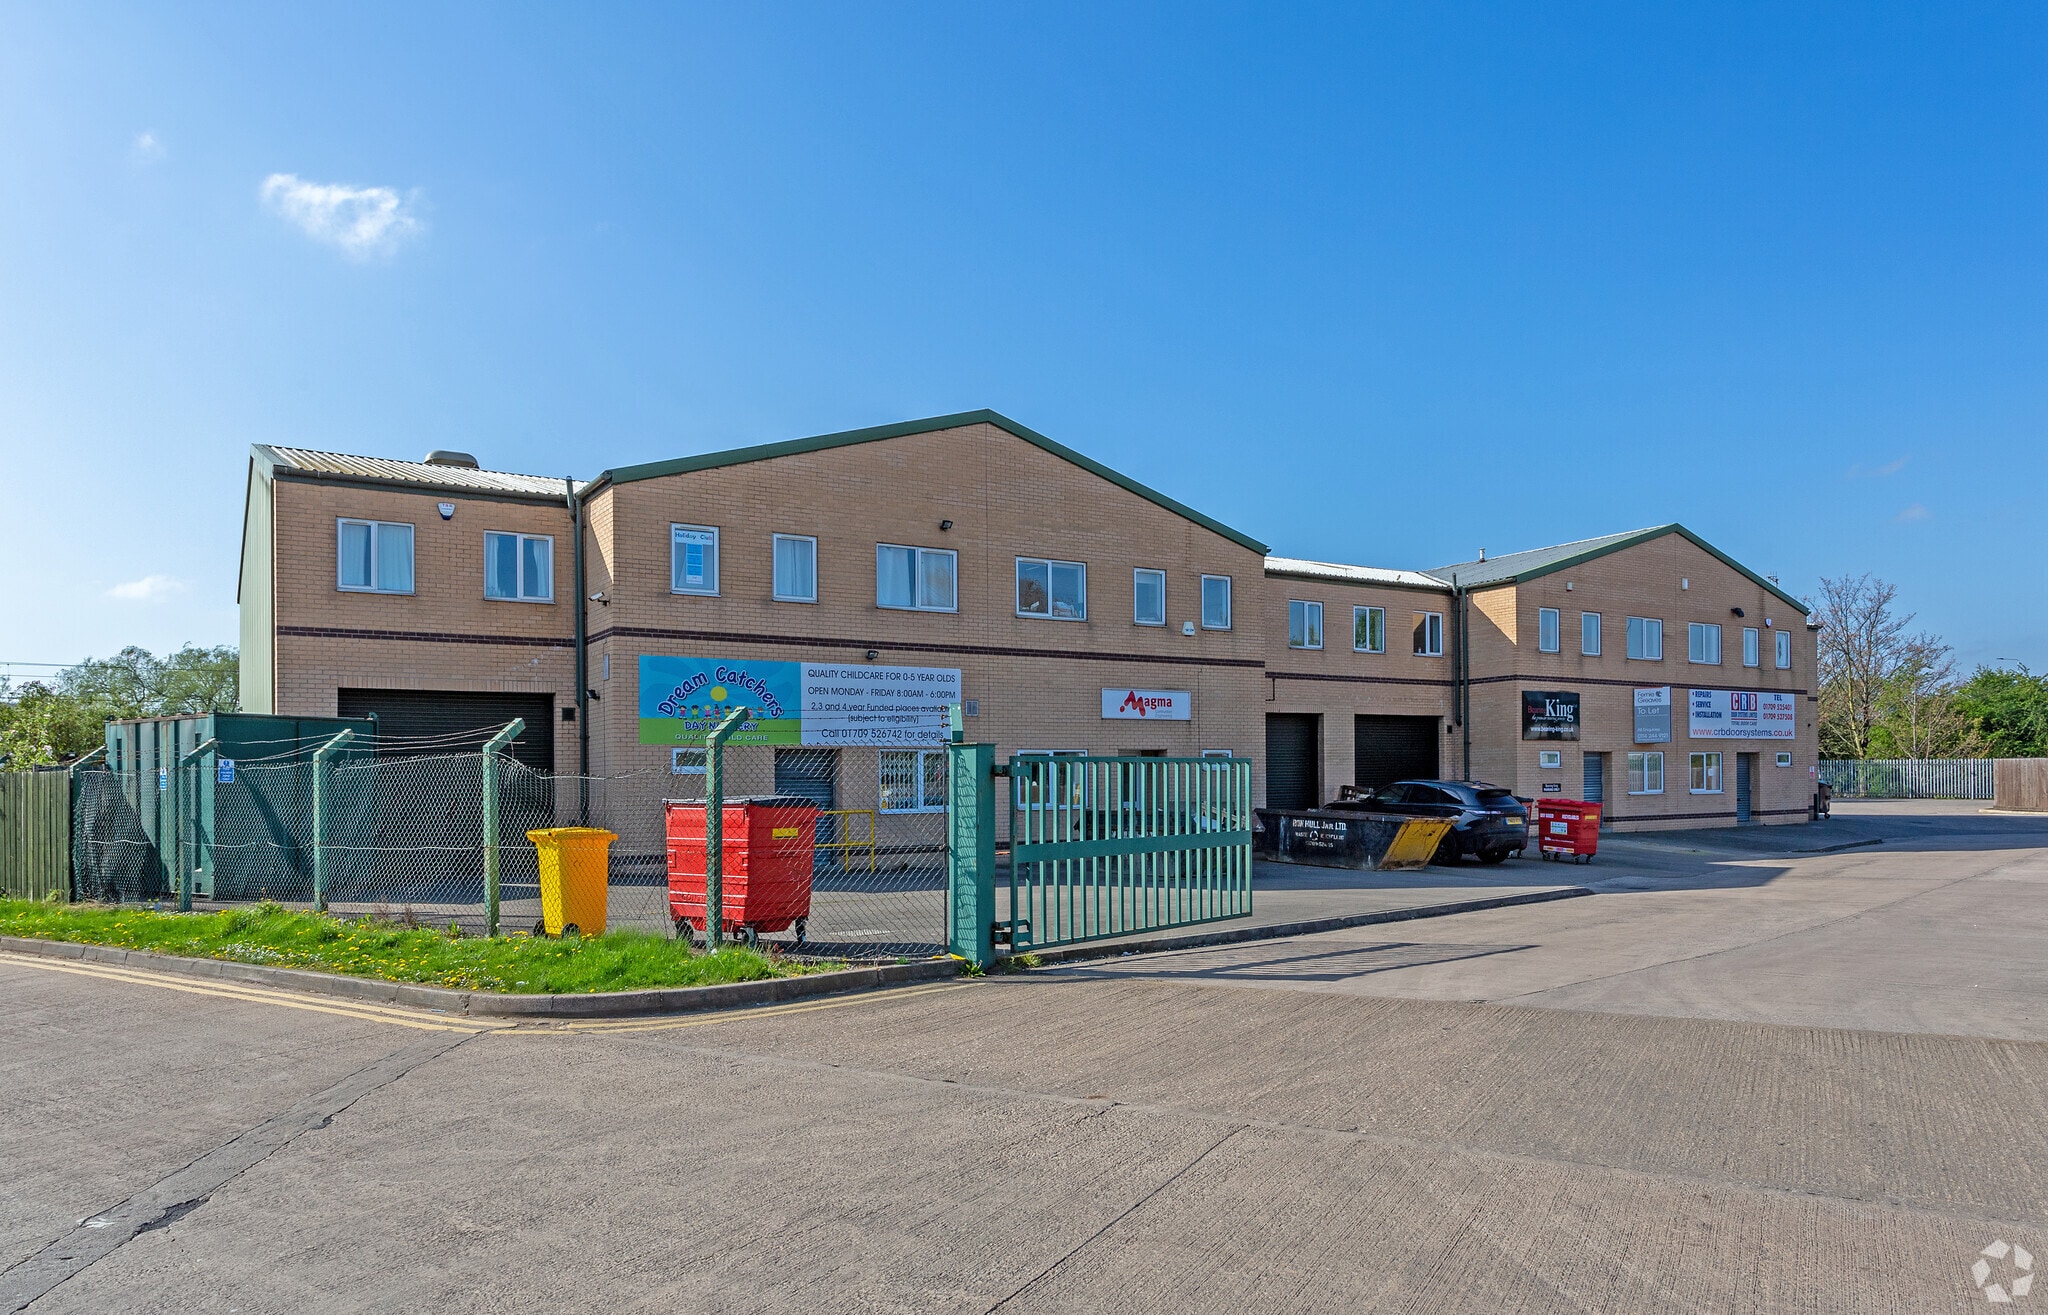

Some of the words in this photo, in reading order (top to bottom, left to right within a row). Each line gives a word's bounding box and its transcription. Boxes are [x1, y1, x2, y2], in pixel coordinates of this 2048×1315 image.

[675, 531, 697, 540] Holiday
[808, 669, 839, 678] QUALITY
[840, 671, 884, 680] CHILDCARE
[886, 672, 901, 681] FOR
[903, 673, 916, 681] 0-5
[917, 673, 935, 682] YEAR
[936, 674, 956, 683] OLDS
[657, 671, 710, 717] Dream
[715, 665, 784, 718] Catchers
[807, 686, 829, 695] OPEN
[830, 687, 865, 696] MONDAY
[870, 688, 895, 697] FRIDAY
[896, 689, 924, 698] 8:00AM
[930, 690, 956, 699] 6:00PM
[1120, 690, 1173, 717] Magma
[1731, 692, 1758, 711] CRB
[824, 703, 840, 712] and
[842, 703, 847, 711] 4
[848, 704, 866, 713] year
[867, 703, 894, 712] Funded
[895, 704, 920, 713] places
[1545, 698, 1574, 723] King
[1637, 707, 1647, 715] To
[1648, 707, 1660, 715] Let
[1763, 703, 1776, 711] 01709
[1695, 711, 1723, 719] INSTALLATION
[1763, 712, 1776, 720] 01709
[684, 720, 707, 731] DAY
[821, 729, 840, 738] Call
[841, 729, 869, 738] 01709
[871, 730, 902, 739] 526742
[904, 730, 916, 739] for
[917, 730, 944, 739] details
[1692, 727, 1793, 738] www.crbdoorsystems.co.uk
[1304, 820, 1320, 829] HULL
